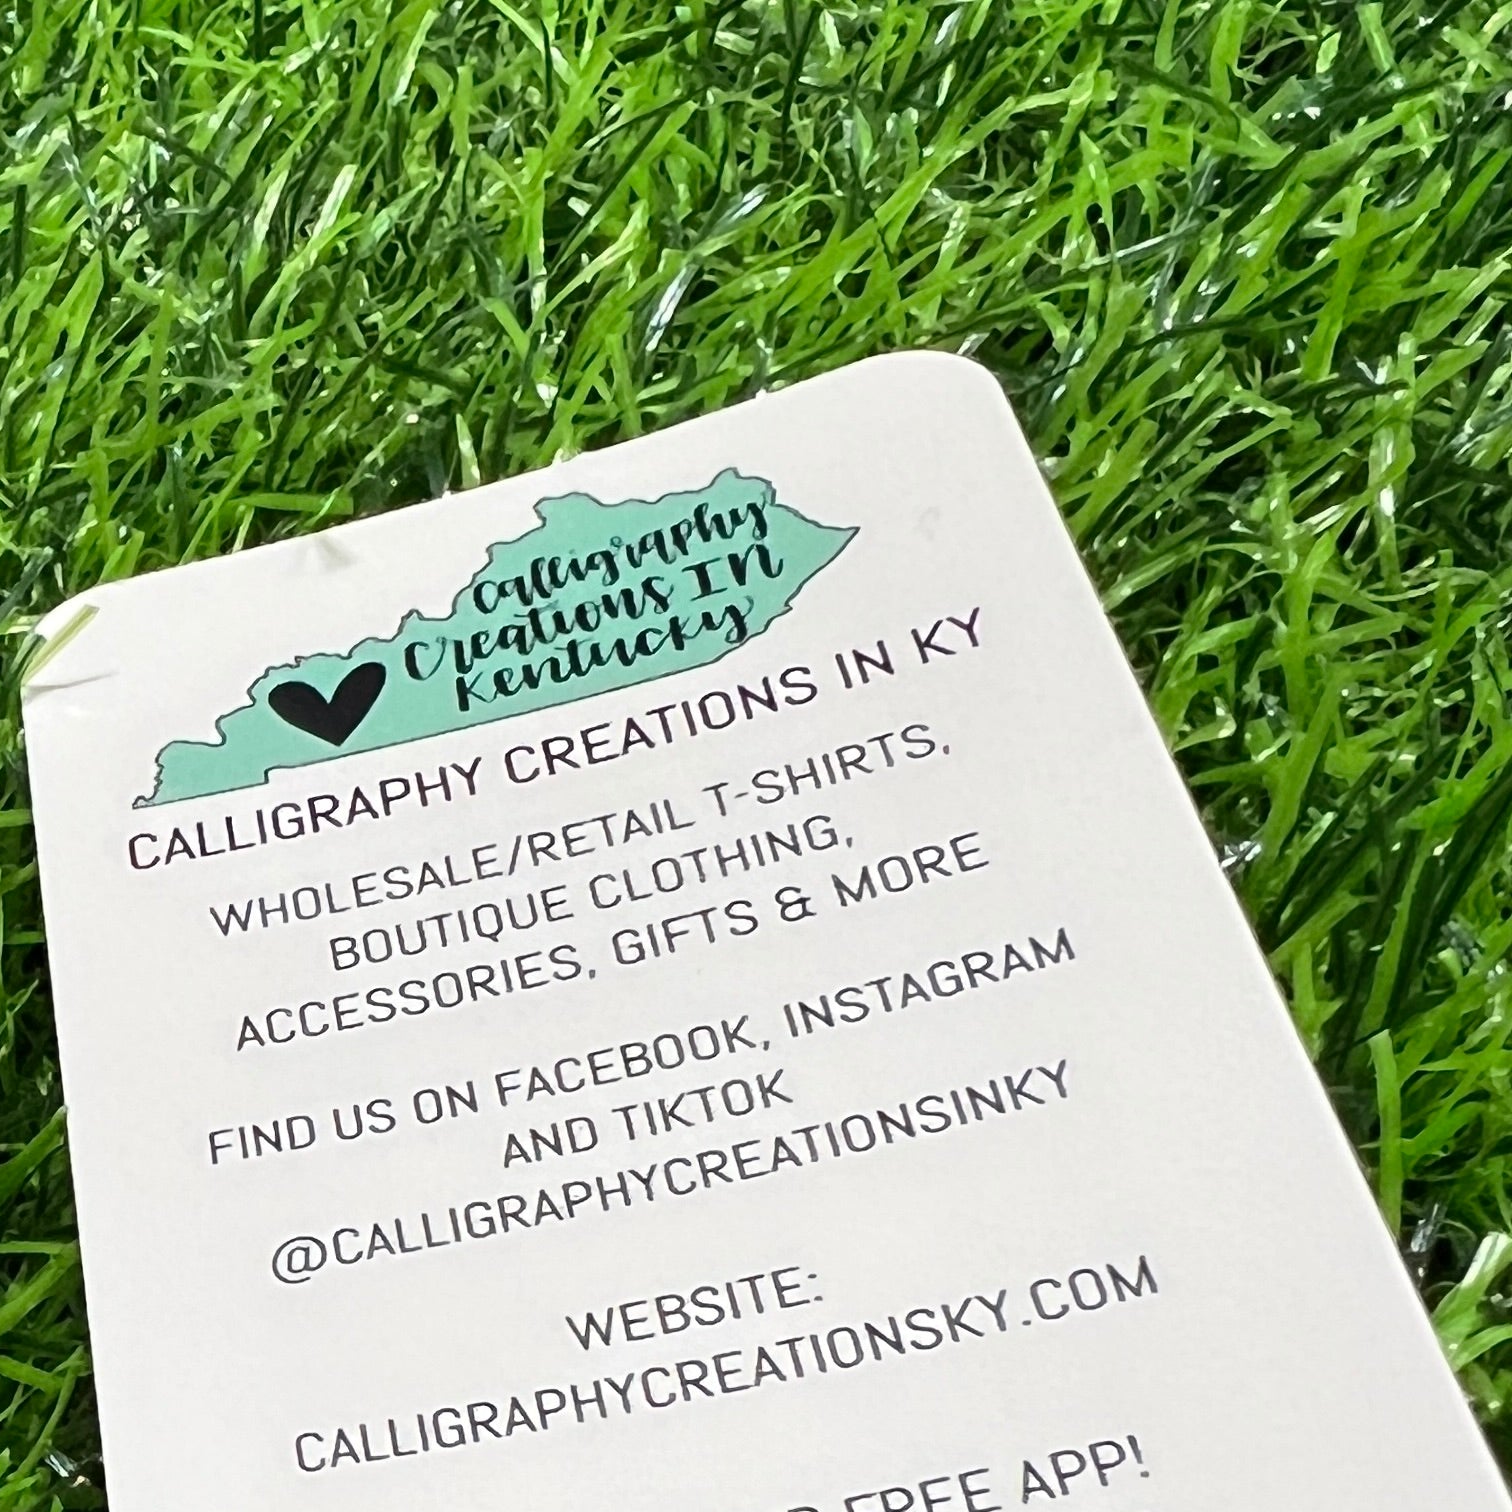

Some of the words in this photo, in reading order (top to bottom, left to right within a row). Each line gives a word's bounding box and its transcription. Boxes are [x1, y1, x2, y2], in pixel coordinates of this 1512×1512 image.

[403, 575, 675, 681] Creations
[127, 755, 484, 871] CALLIGRAPHY
[502, 665, 820, 785] CREATIONS
[833, 638, 896, 691] IN
[909, 605, 982, 666] KY
[208, 797, 698, 938] WHOLESALE/RETAIL
[700, 722, 951, 818] T-SHIRTS,
[235, 942, 598, 1053] ACCESSORIES,
[610, 898, 760, 966] GIFTS
[772, 884, 819, 924] &
[829, 830, 991, 909] MORE
[327, 882, 576, 973] BOUTIQUE
[587, 813, 854, 911] CLOTHING,
[207, 1114, 318, 1167] FIND
[331, 1097, 398, 1142] US
[411, 1079, 480, 1126] ON
[493, 1013, 772, 1109] FACEBOOK,
[781, 926, 1077, 1039] INSTAGRAM
[502, 1115, 600, 1170] AND
[609, 1067, 795, 1142] TIKTOK
[270, 1057, 1069, 1286] @CALLIGRAPHYCREATIONSINKY
[294, 1253, 1160, 1474] CALLIGRAPHYCREATIONSKY.COM
[563, 1264, 825, 1353] WEBSITE:
[1020, 1433, 1151, 1506] APP!
